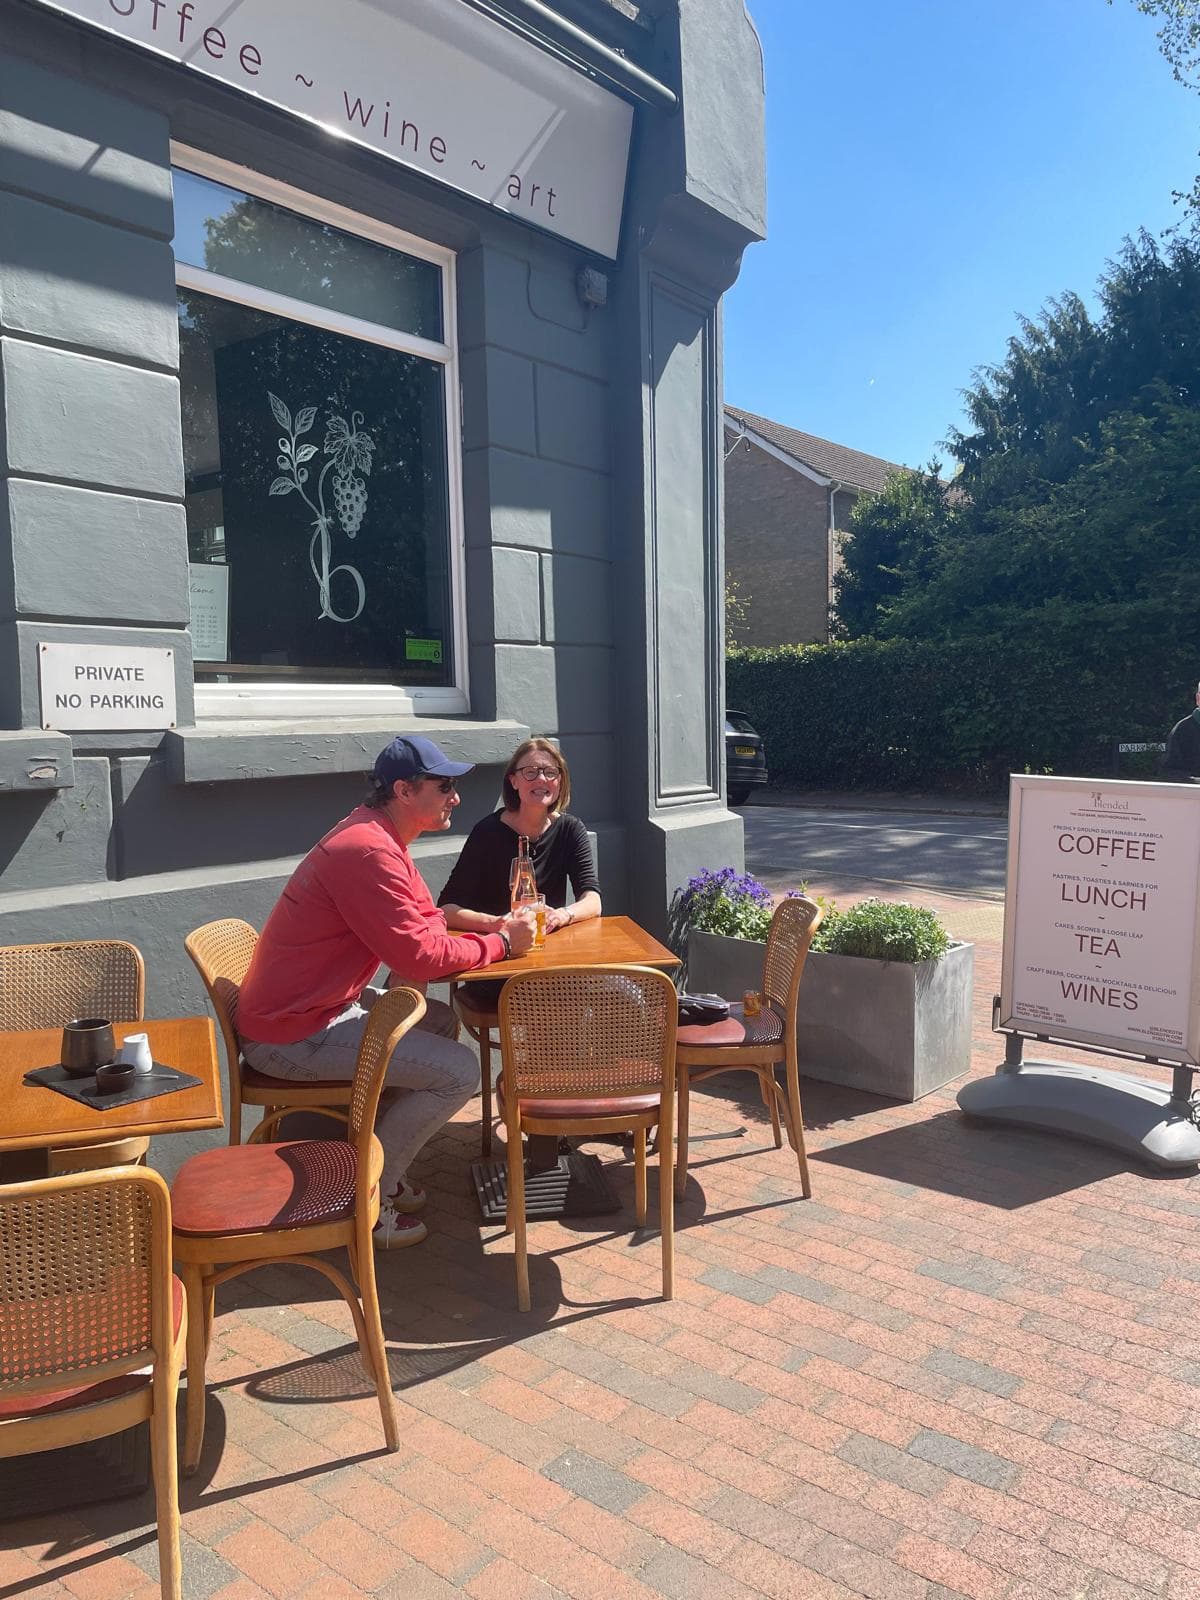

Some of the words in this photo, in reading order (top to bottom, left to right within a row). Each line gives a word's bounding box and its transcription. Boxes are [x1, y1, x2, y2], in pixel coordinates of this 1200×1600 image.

[343, 90, 447, 163] wine
[507, 174, 557, 217] art
[74, 665, 145, 682] PRIVATE
[55, 693, 82, 709] NO
[90, 693, 164, 709] PARKING
[1101, 829, 1137, 837] SUSTAINABLE
[1058, 833, 1156, 861] COFFEE
[1083, 876, 1112, 885] TOASTIES
[1118, 880, 1144, 888] SARNIES
[1061, 882, 1147, 911] LUNCH
[1076, 925, 1100, 934] SCONES
[1107, 929, 1127, 937] LOOSE
[1074, 933, 1121, 958] TEA
[1061, 980, 1138, 1011] WINES
[1102, 978, 1137, 989] MOCKTAILS
[1143, 985, 1177, 996] DELICIOUS
